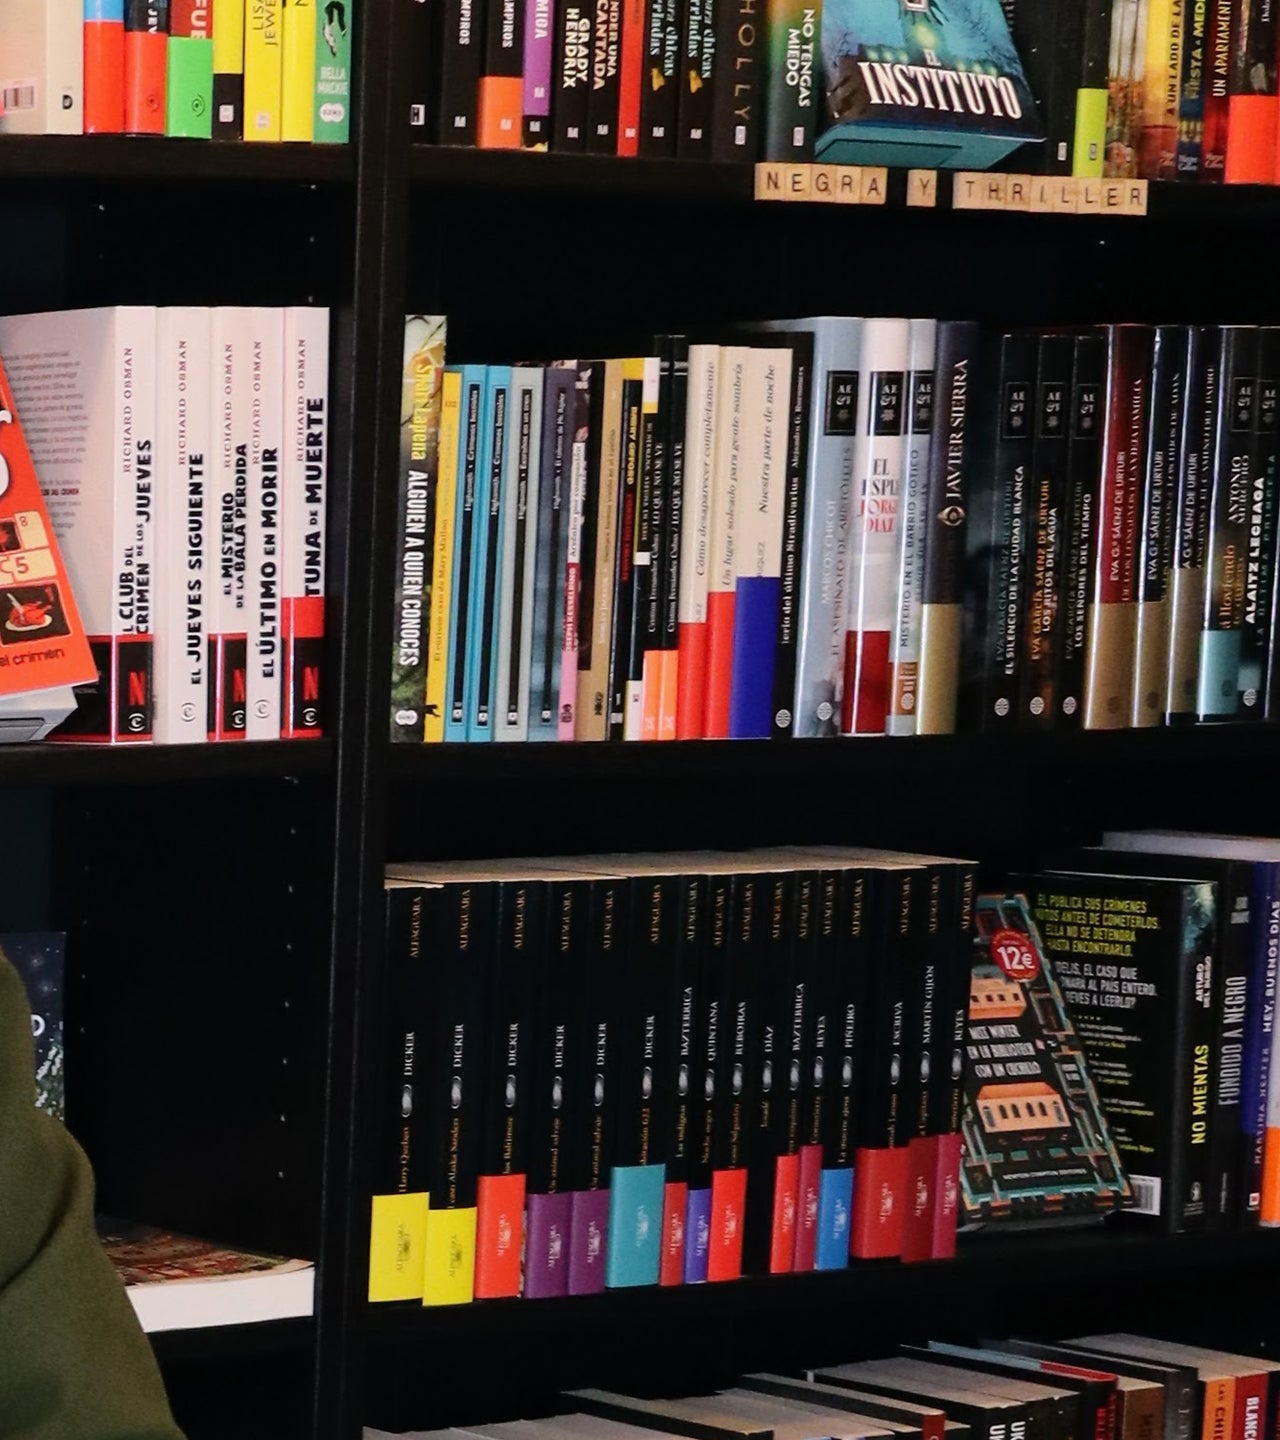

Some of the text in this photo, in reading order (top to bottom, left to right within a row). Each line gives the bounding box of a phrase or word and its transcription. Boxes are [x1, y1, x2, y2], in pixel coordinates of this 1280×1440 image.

[786, 29, 799, 86] MIEDO
[799, 9, 814, 108] NO TENGAS
[925, 48, 938, 66] EL
[858, 63, 1021, 119] INSTITUTO
[767, 173, 880, 195] NEGRA
[921, 178, 929, 192] Y
[187, 453, 204, 684] EL JUEVES SIGUIENTE
[400, 470, 429, 667] ALGUIEN A QUIEN CONOCES
